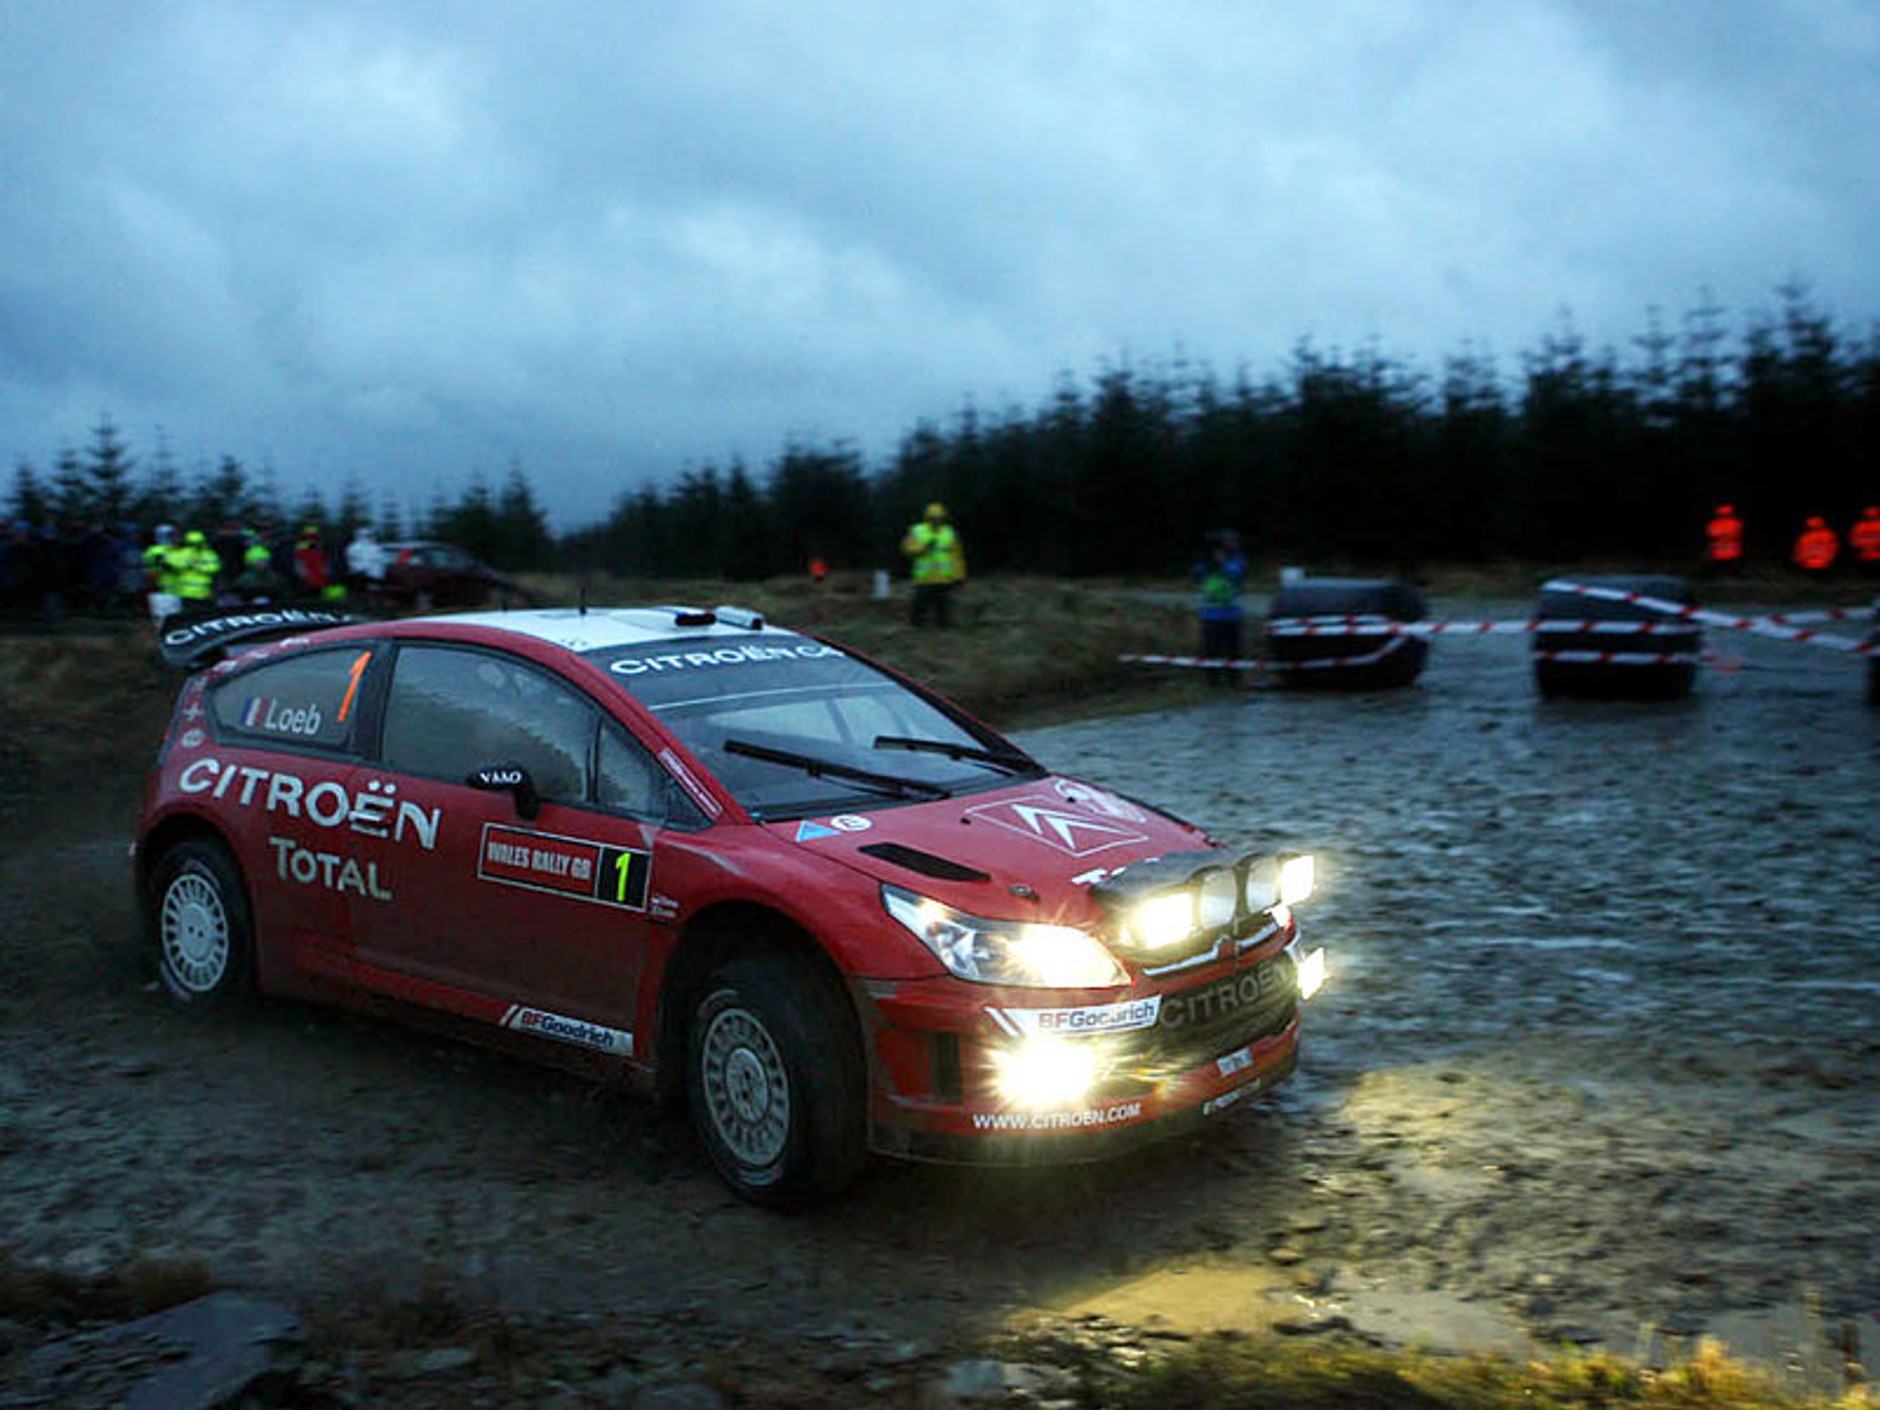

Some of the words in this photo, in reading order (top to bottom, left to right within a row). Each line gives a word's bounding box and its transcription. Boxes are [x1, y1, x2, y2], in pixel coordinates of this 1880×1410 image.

[338, 651, 371, 722] 1
[264, 703, 321, 735] Loeb
[180, 758, 441, 850] CITROËN
[268, 836, 394, 900] TOTAL
[488, 841, 530, 869] WALES
[532, 849, 568, 876] RALLY
[571, 858, 592, 881] GB
[615, 852, 631, 902] 1
[521, 1008, 615, 1048] BFGoodrich
[1039, 1002, 1156, 1029] BFGoodrich
